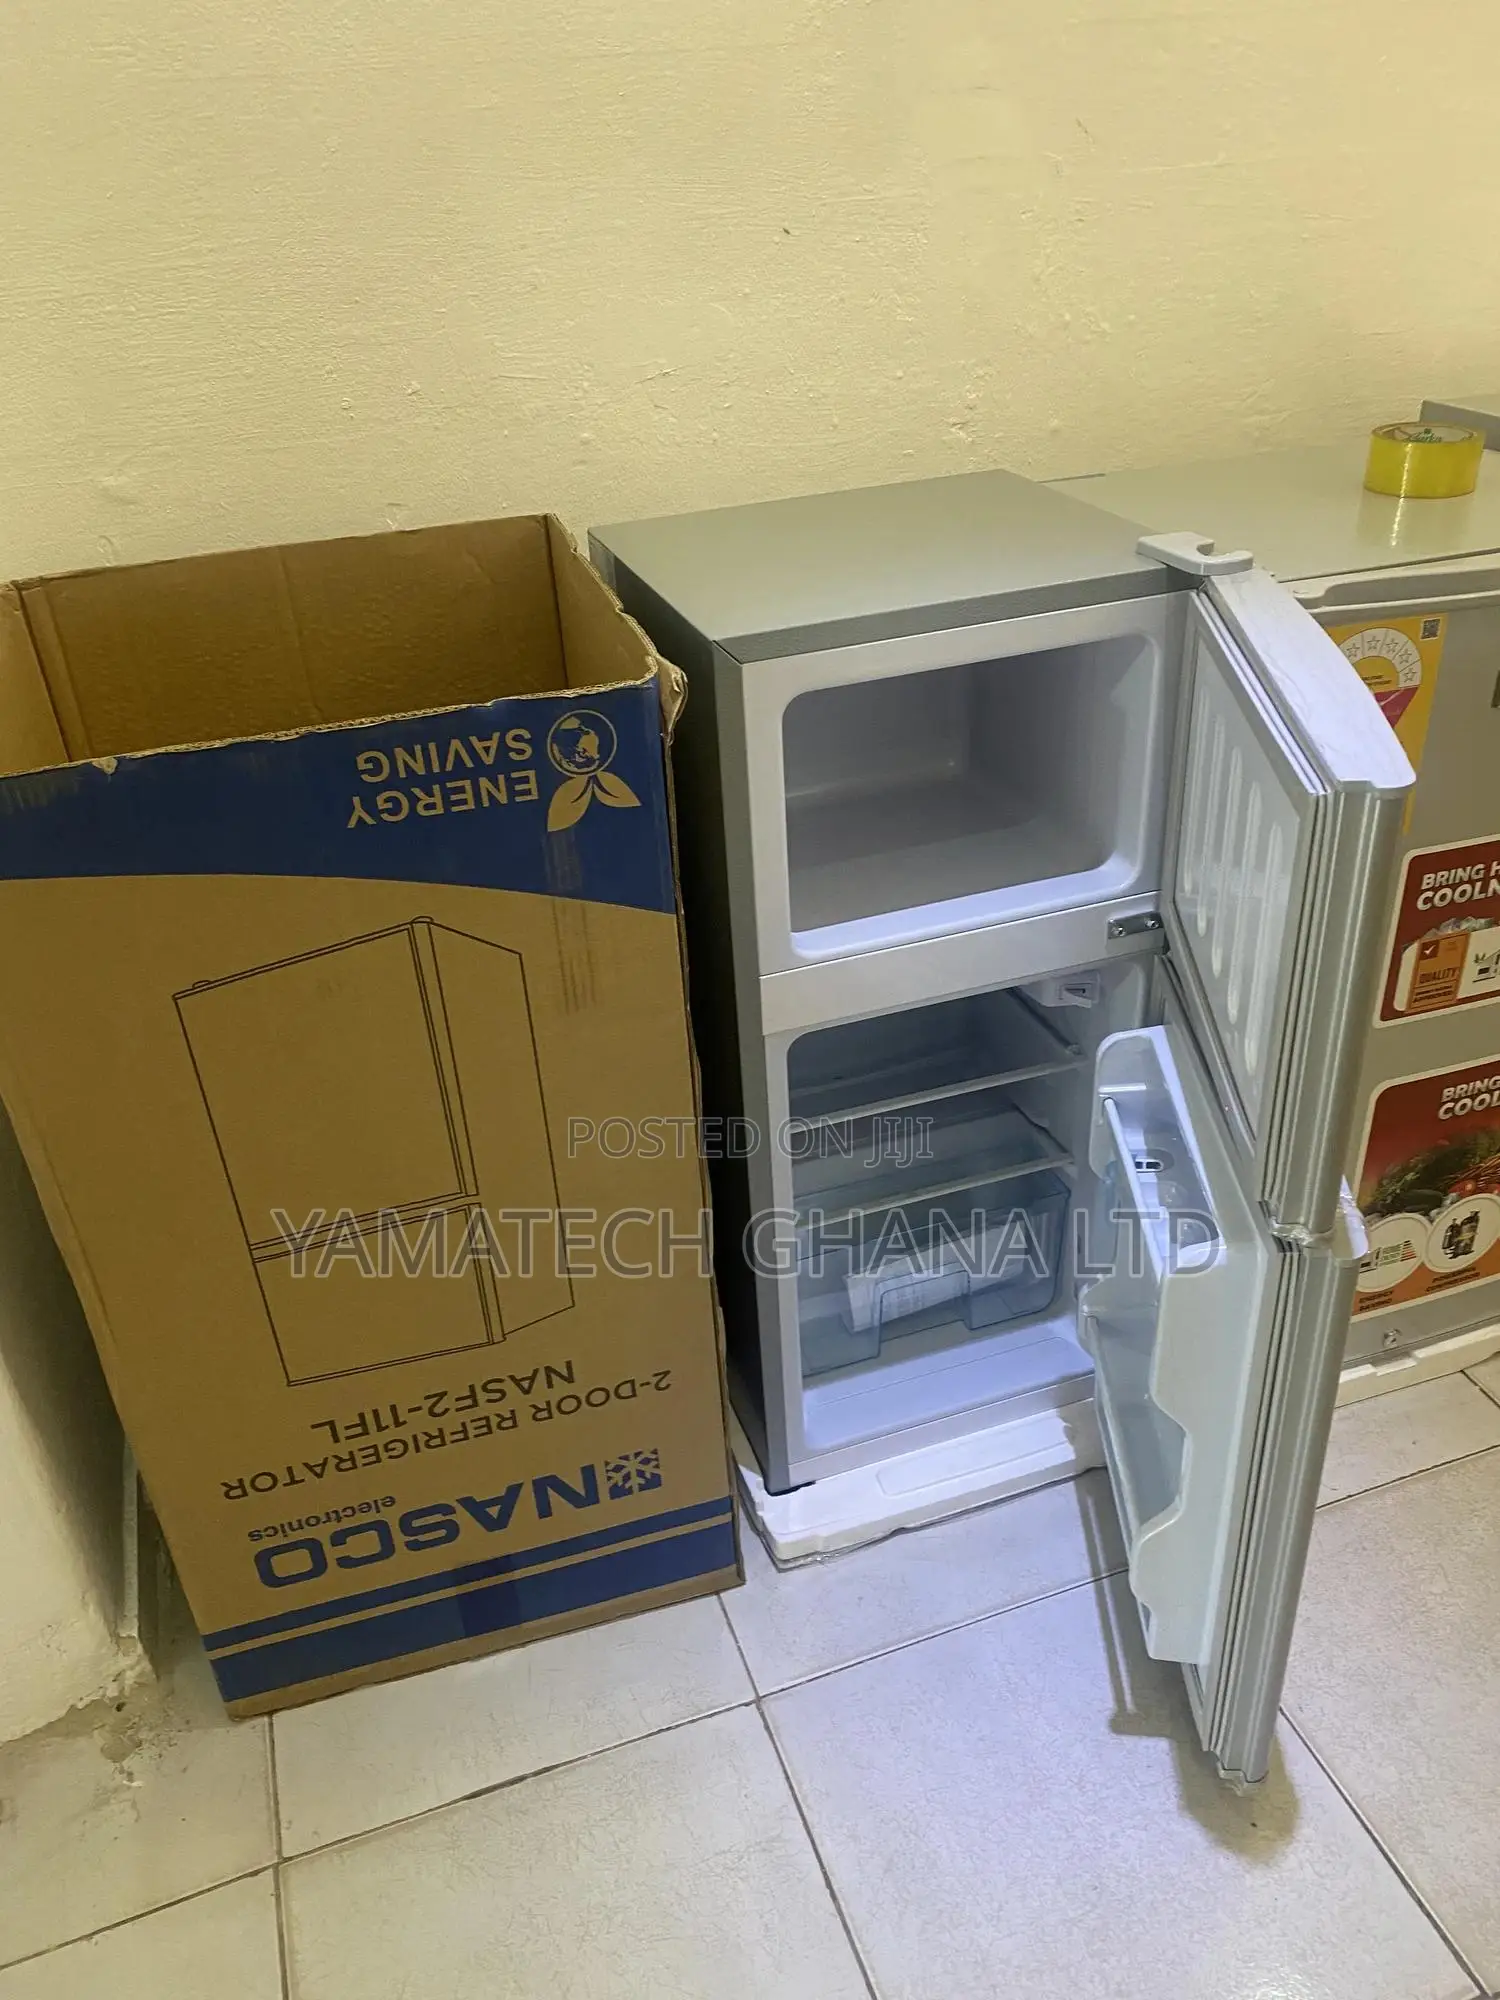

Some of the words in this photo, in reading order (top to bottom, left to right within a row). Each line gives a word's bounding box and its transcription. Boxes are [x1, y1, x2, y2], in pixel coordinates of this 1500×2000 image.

[356, 728, 532, 783] SAVING
[347, 769, 539, 829] ENERGY
[1421, 863, 1485, 890] BRING
[1441, 1075, 1500, 1103] BRING
[310, 1360, 575, 1444] NASF2-11FL
[529, 1369, 672, 1423] 2-DOOR
[220, 1408, 520, 1501] REFRIGERATOR
[247, 1495, 397, 1543] electronics
[253, 1463, 601, 1589] NASCO
